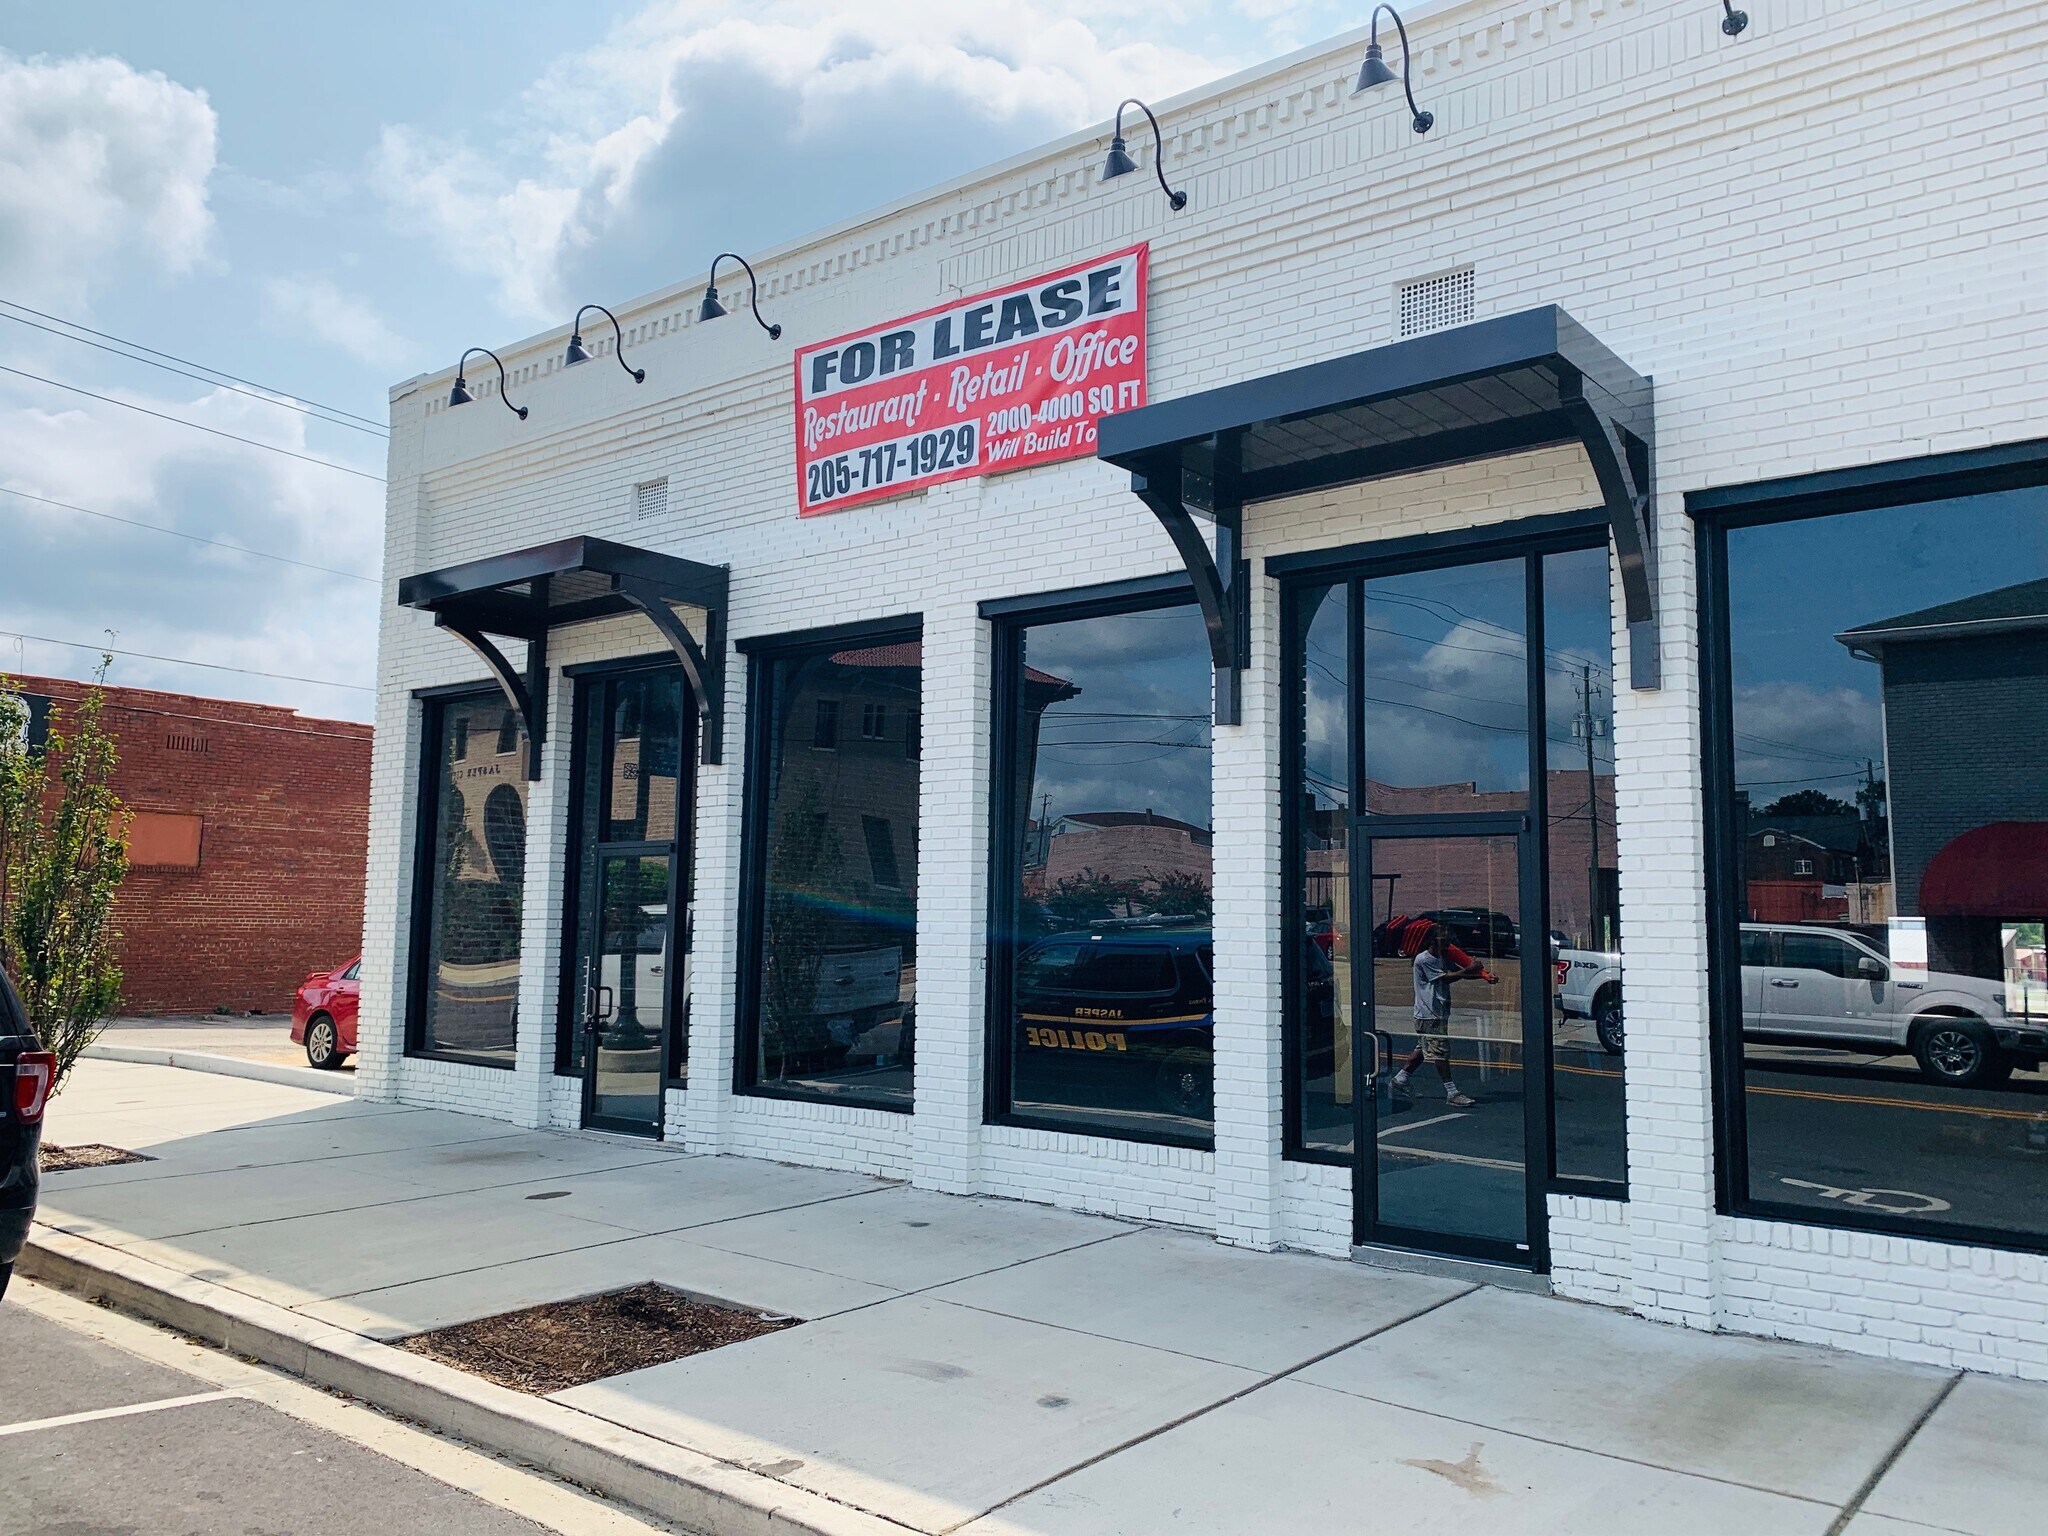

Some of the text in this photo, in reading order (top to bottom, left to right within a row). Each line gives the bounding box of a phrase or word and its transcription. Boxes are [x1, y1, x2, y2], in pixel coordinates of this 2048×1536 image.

[811, 265, 1122, 394] FOR LEASE
[803, 329, 1139, 452] Restaurant Retail Office
[986, 380, 1141, 438] 2000-4000 SQ FT
[808, 424, 975, 502] 205-717-1929
[984, 420, 1098, 463] Will Build To
